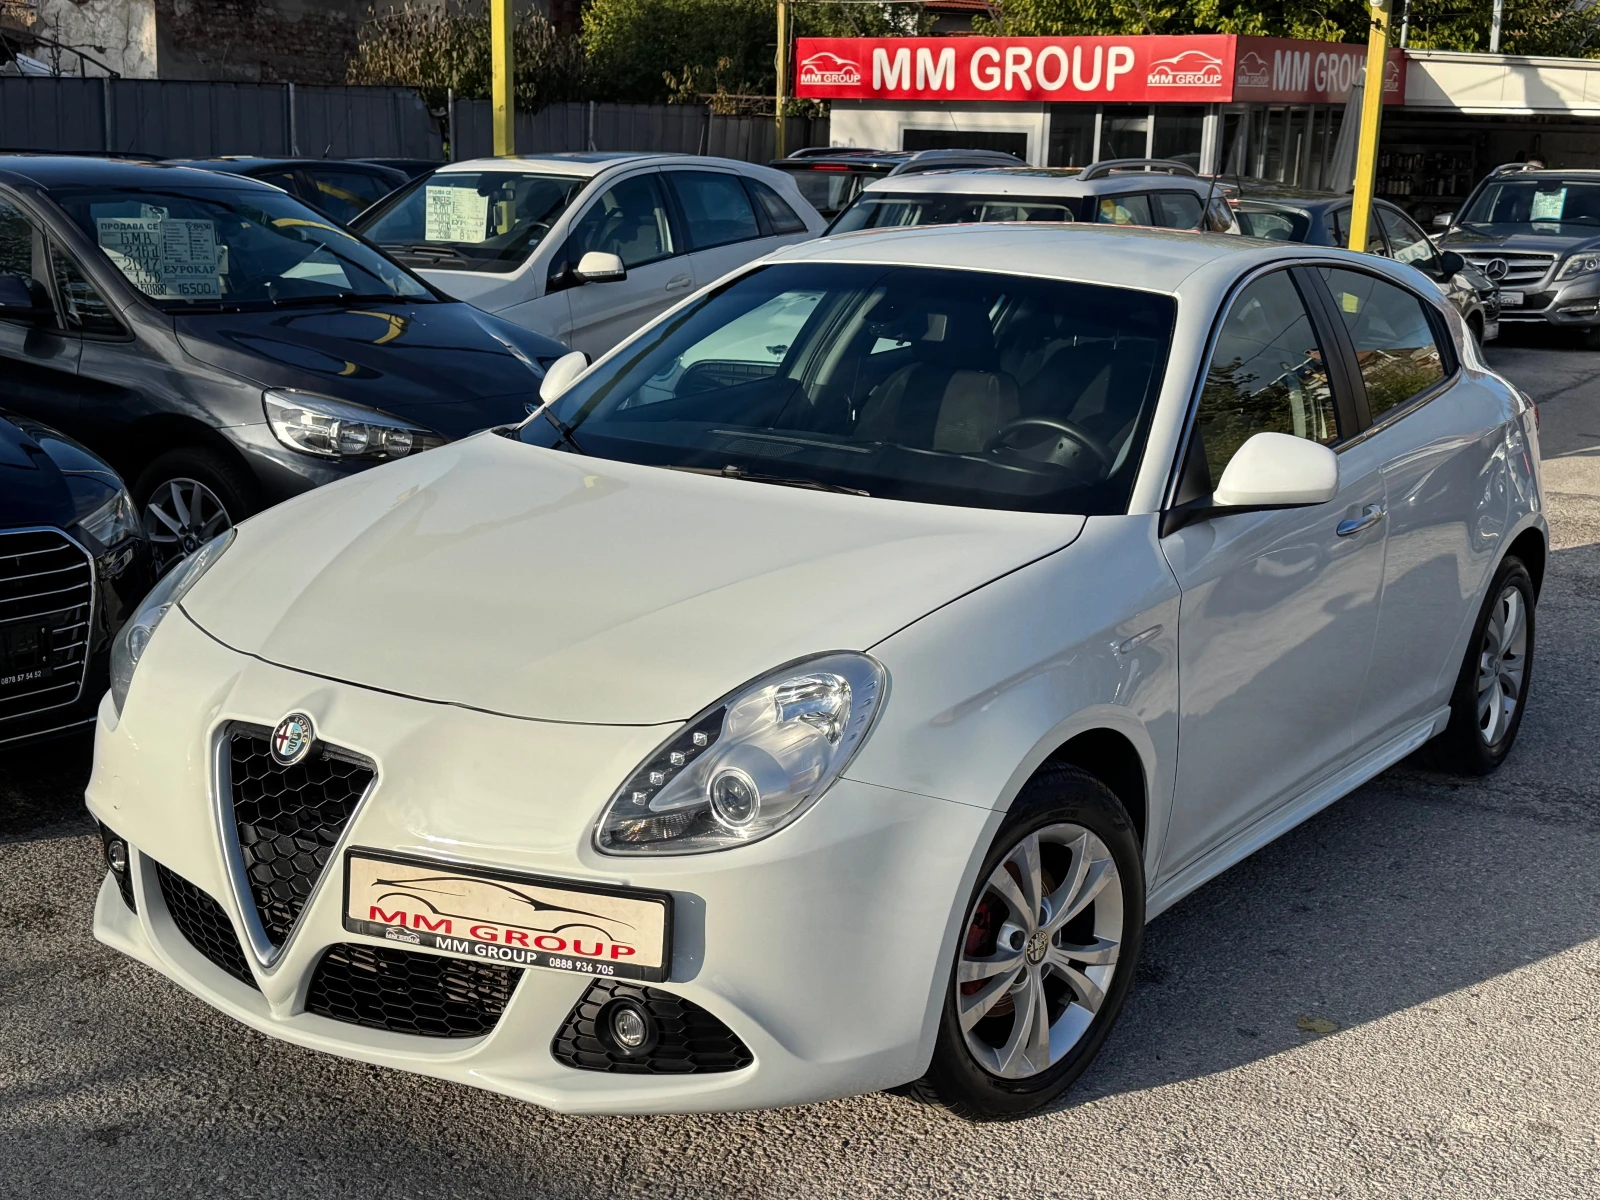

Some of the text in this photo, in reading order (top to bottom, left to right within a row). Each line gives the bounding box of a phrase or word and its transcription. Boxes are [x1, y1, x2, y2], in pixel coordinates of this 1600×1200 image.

[872, 45, 1135, 92] MM GROUP
[1272, 49, 1367, 92] MM GROU
[800, 73, 861, 83] MM GROUP
[1147, 74, 1222, 84] MM GROUP
[1237, 75, 1269, 85] MM GROUP
[100, 222, 145, 231] ПРОДАВА
[122, 257, 159, 271] 2017
[163, 265, 216, 274] ЕУРОКАР
[177, 282, 211, 294] 16500
[0, 676, 16, 685] 0878
[369, 905, 636, 960] MM GROUP
[435, 936, 614, 975] MM GROUP 0888 936 705
